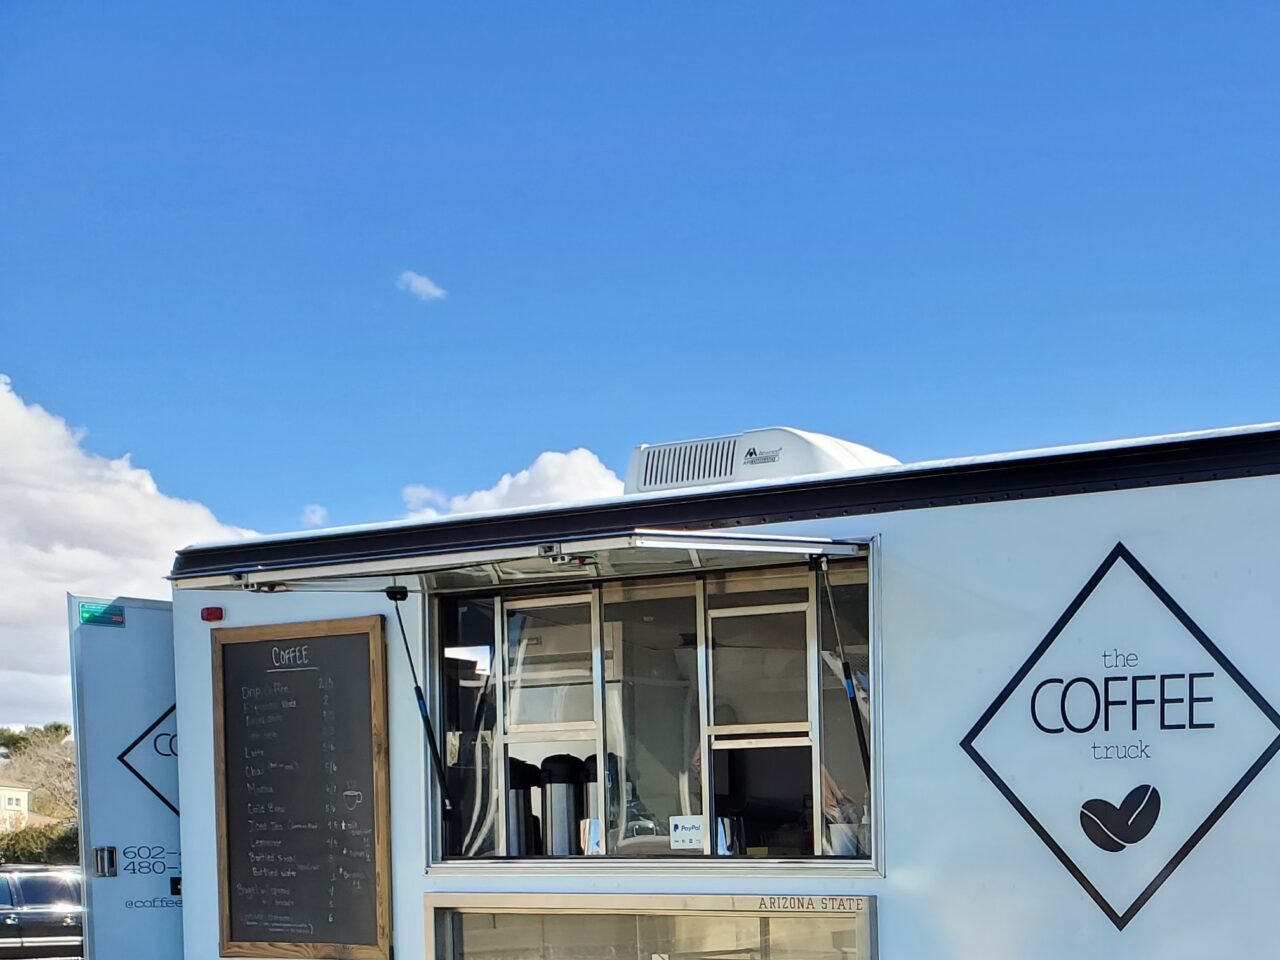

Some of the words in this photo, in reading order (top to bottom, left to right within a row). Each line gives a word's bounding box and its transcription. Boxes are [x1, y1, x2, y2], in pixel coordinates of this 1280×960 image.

[271, 645, 309, 667] COFFEE
[1101, 649, 1139, 668] the
[1030, 672, 1215, 734] COFFEE
[1091, 740, 1151, 760] truck
[123, 846, 182, 859] 602-
[123, 860, 182, 874] 480-
[758, 896, 815, 910] ARIZONA
[821, 897, 863, 911] STATE
